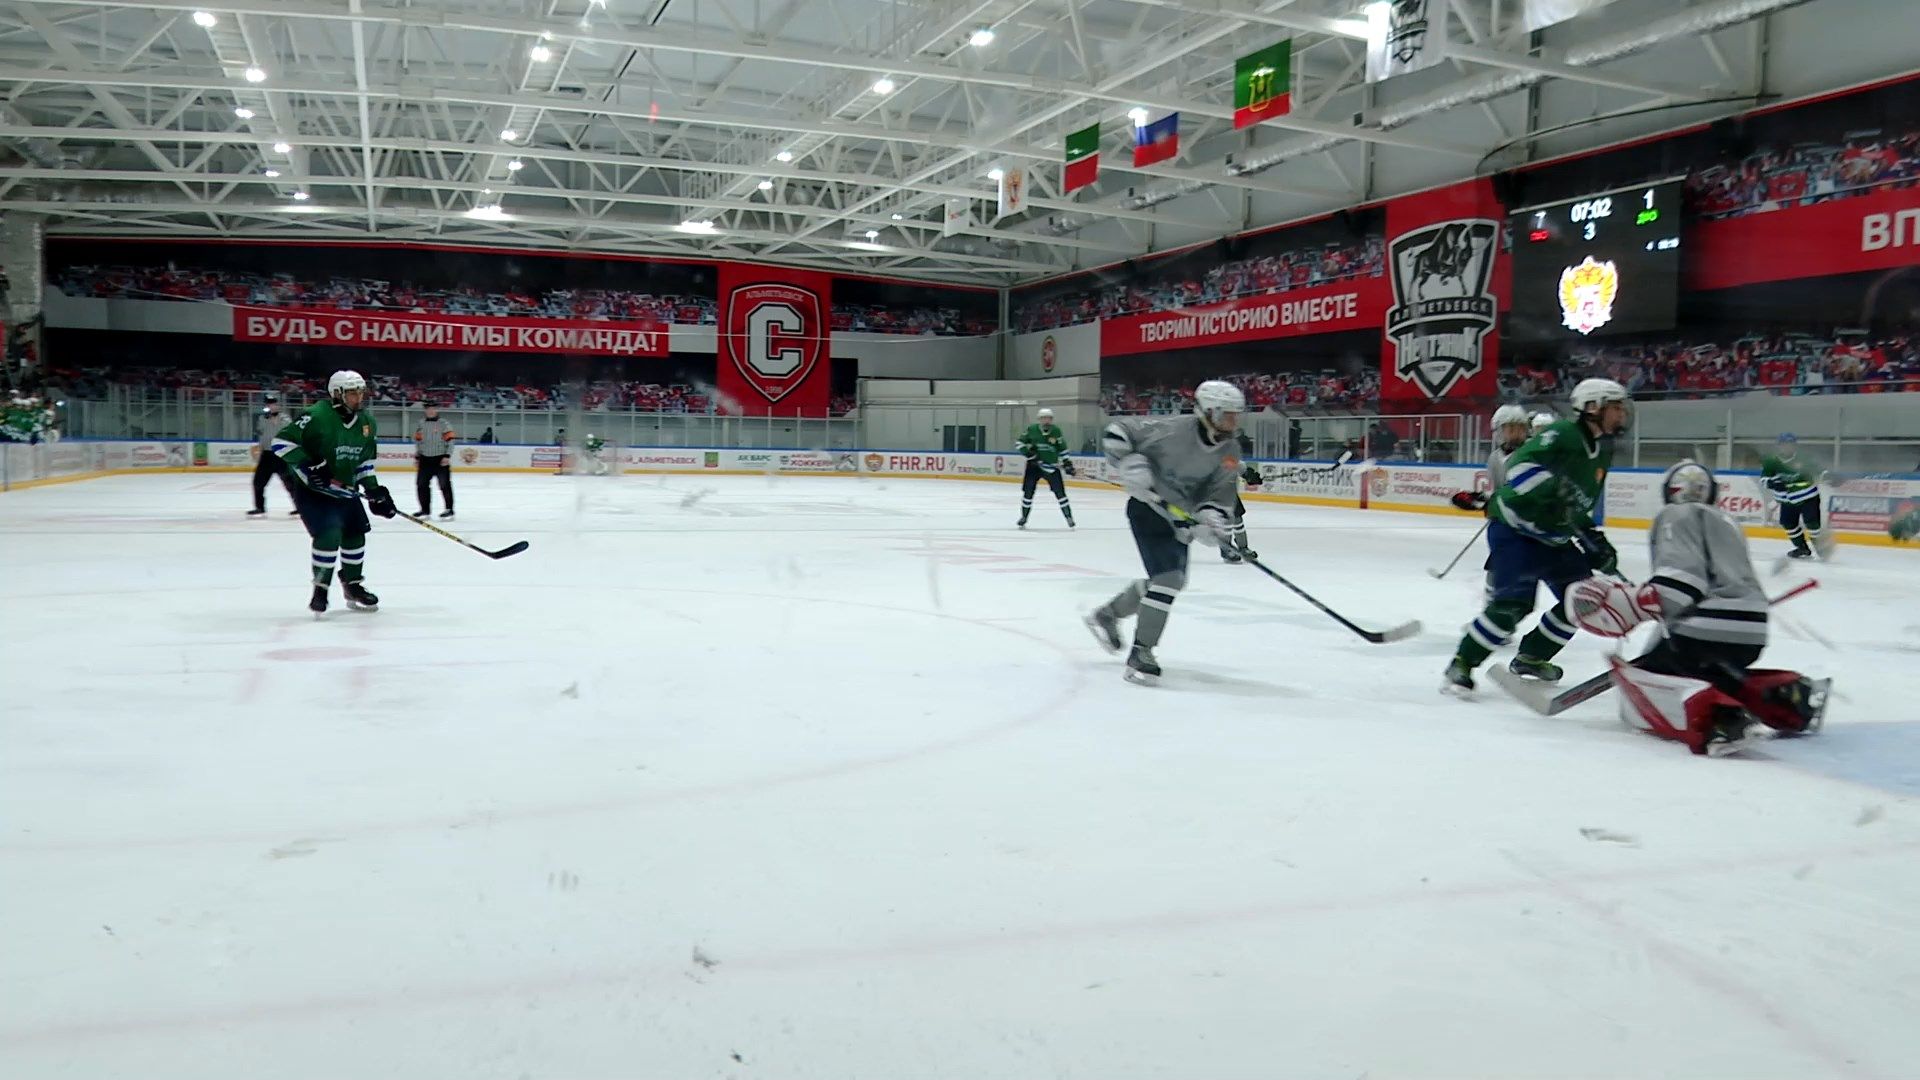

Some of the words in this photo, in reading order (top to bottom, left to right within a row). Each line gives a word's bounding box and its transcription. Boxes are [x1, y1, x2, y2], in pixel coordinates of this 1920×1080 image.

[1643, 188, 1654, 209] 1
[1571, 198, 1612, 223] 07:02
[1584, 222, 1596, 241] 3
[1139, 317, 1197, 343] ТВОРИМ
[1198, 305, 1278, 336] ИСТОРИЮ
[1280, 293, 1358, 326] ВМЕСТЕ
[247, 316, 328, 343] БУДЬ
[333, 320, 355, 341] С
[360, 321, 454, 345] НАМИ!
[461, 325, 511, 347] МЫ
[517, 327, 658, 355] КОМАНДА!
[889, 455, 946, 472] FHR.RU
